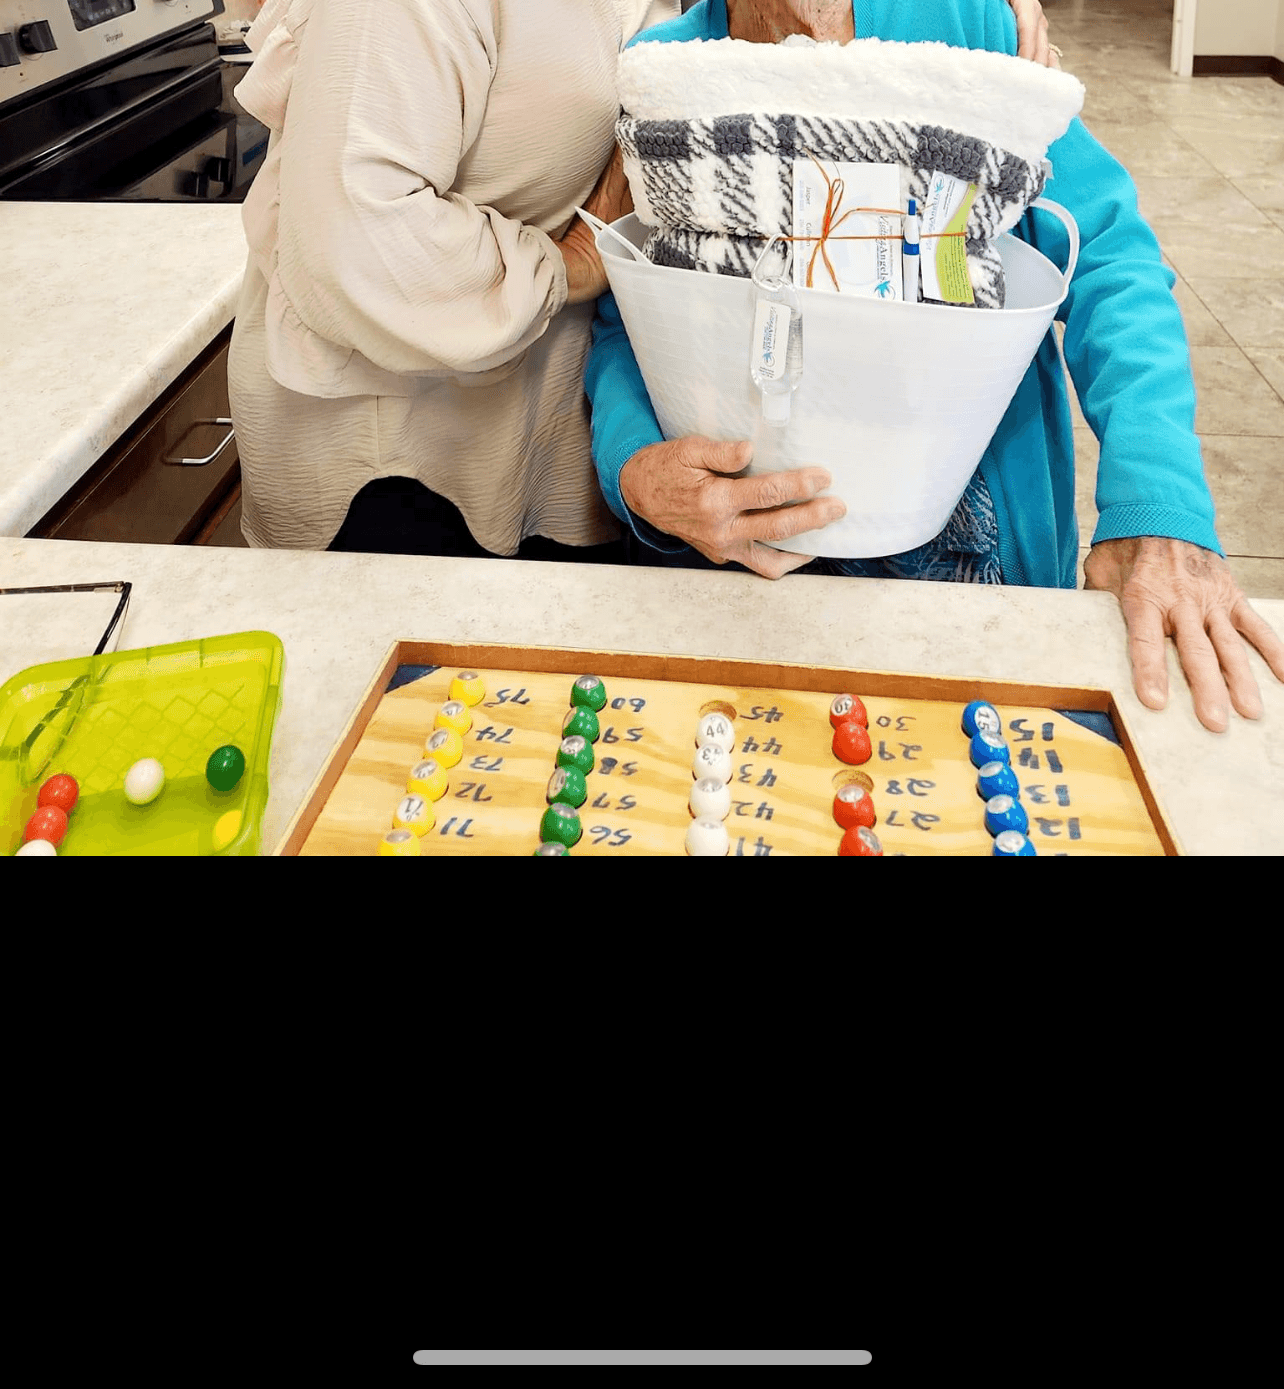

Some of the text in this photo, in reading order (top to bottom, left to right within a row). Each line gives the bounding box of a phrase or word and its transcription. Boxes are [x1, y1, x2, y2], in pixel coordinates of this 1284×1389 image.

[484, 688, 529, 708] 75
[611, 697, 646, 712] 60
[739, 706, 784, 723] 45
[876, 716, 916, 731] 30
[475, 726, 514, 743] 74
[602, 727, 645, 743] 59
[1009, 719, 1054, 742] 15
[742, 736, 783, 755] 44
[878, 741, 922, 760] 29
[469, 755, 503, 771] 73
[738, 764, 777, 787] 43
[455, 782, 492, 802] 72
[885, 778, 936, 796] 28
[1025, 785, 1070, 806] 13
[592, 792, 637, 810] 57
[732, 801, 774, 820] 42
[440, 817, 474, 838] 71
[885, 810, 941, 830] 27
[1033, 817, 1081, 839] 12
[590, 825, 632, 846] 56
